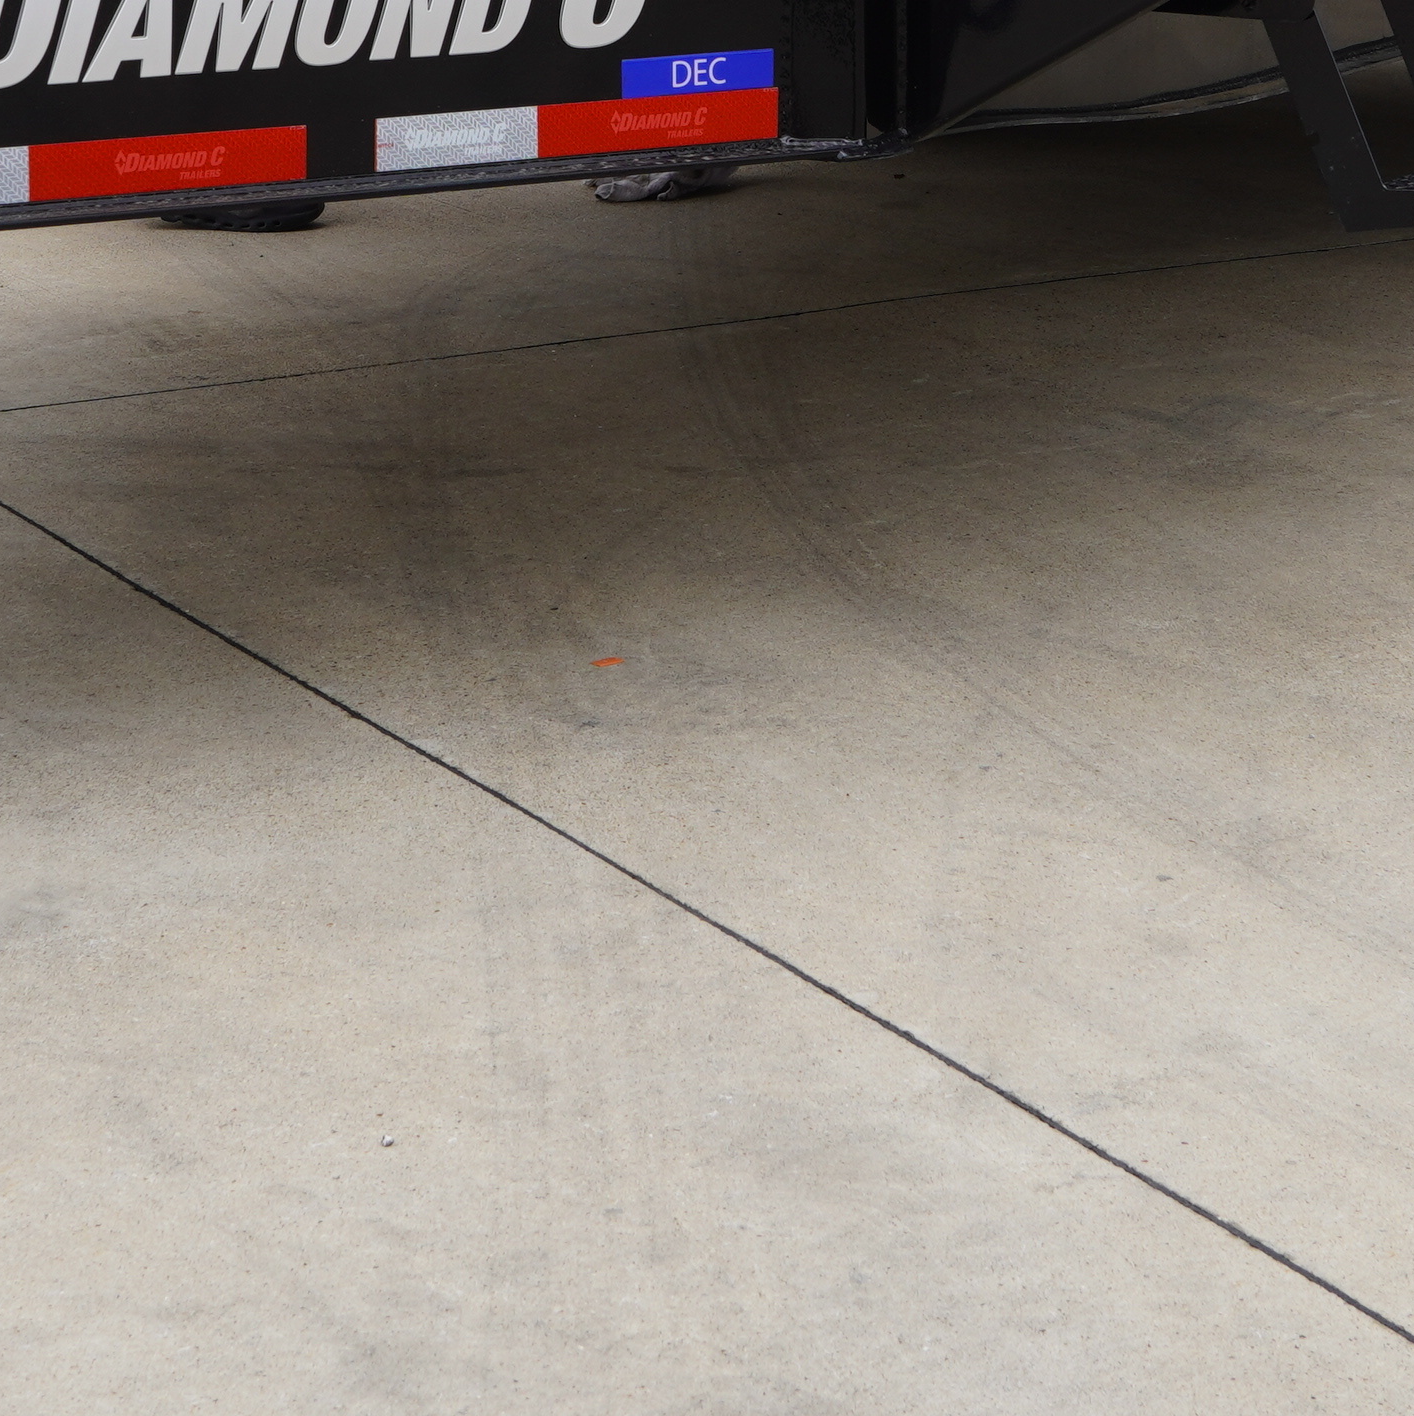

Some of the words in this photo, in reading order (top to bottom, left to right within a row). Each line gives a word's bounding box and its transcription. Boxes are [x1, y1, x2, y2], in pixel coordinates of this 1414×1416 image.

[672, 57, 727, 88] DEC
[619, 110, 692, 132] DIAMOND
[694, 106, 708, 126] C
[124, 150, 208, 173] DIAMOND
[210, 145, 226, 166] C
[179, 169, 221, 181] TRAILERS
